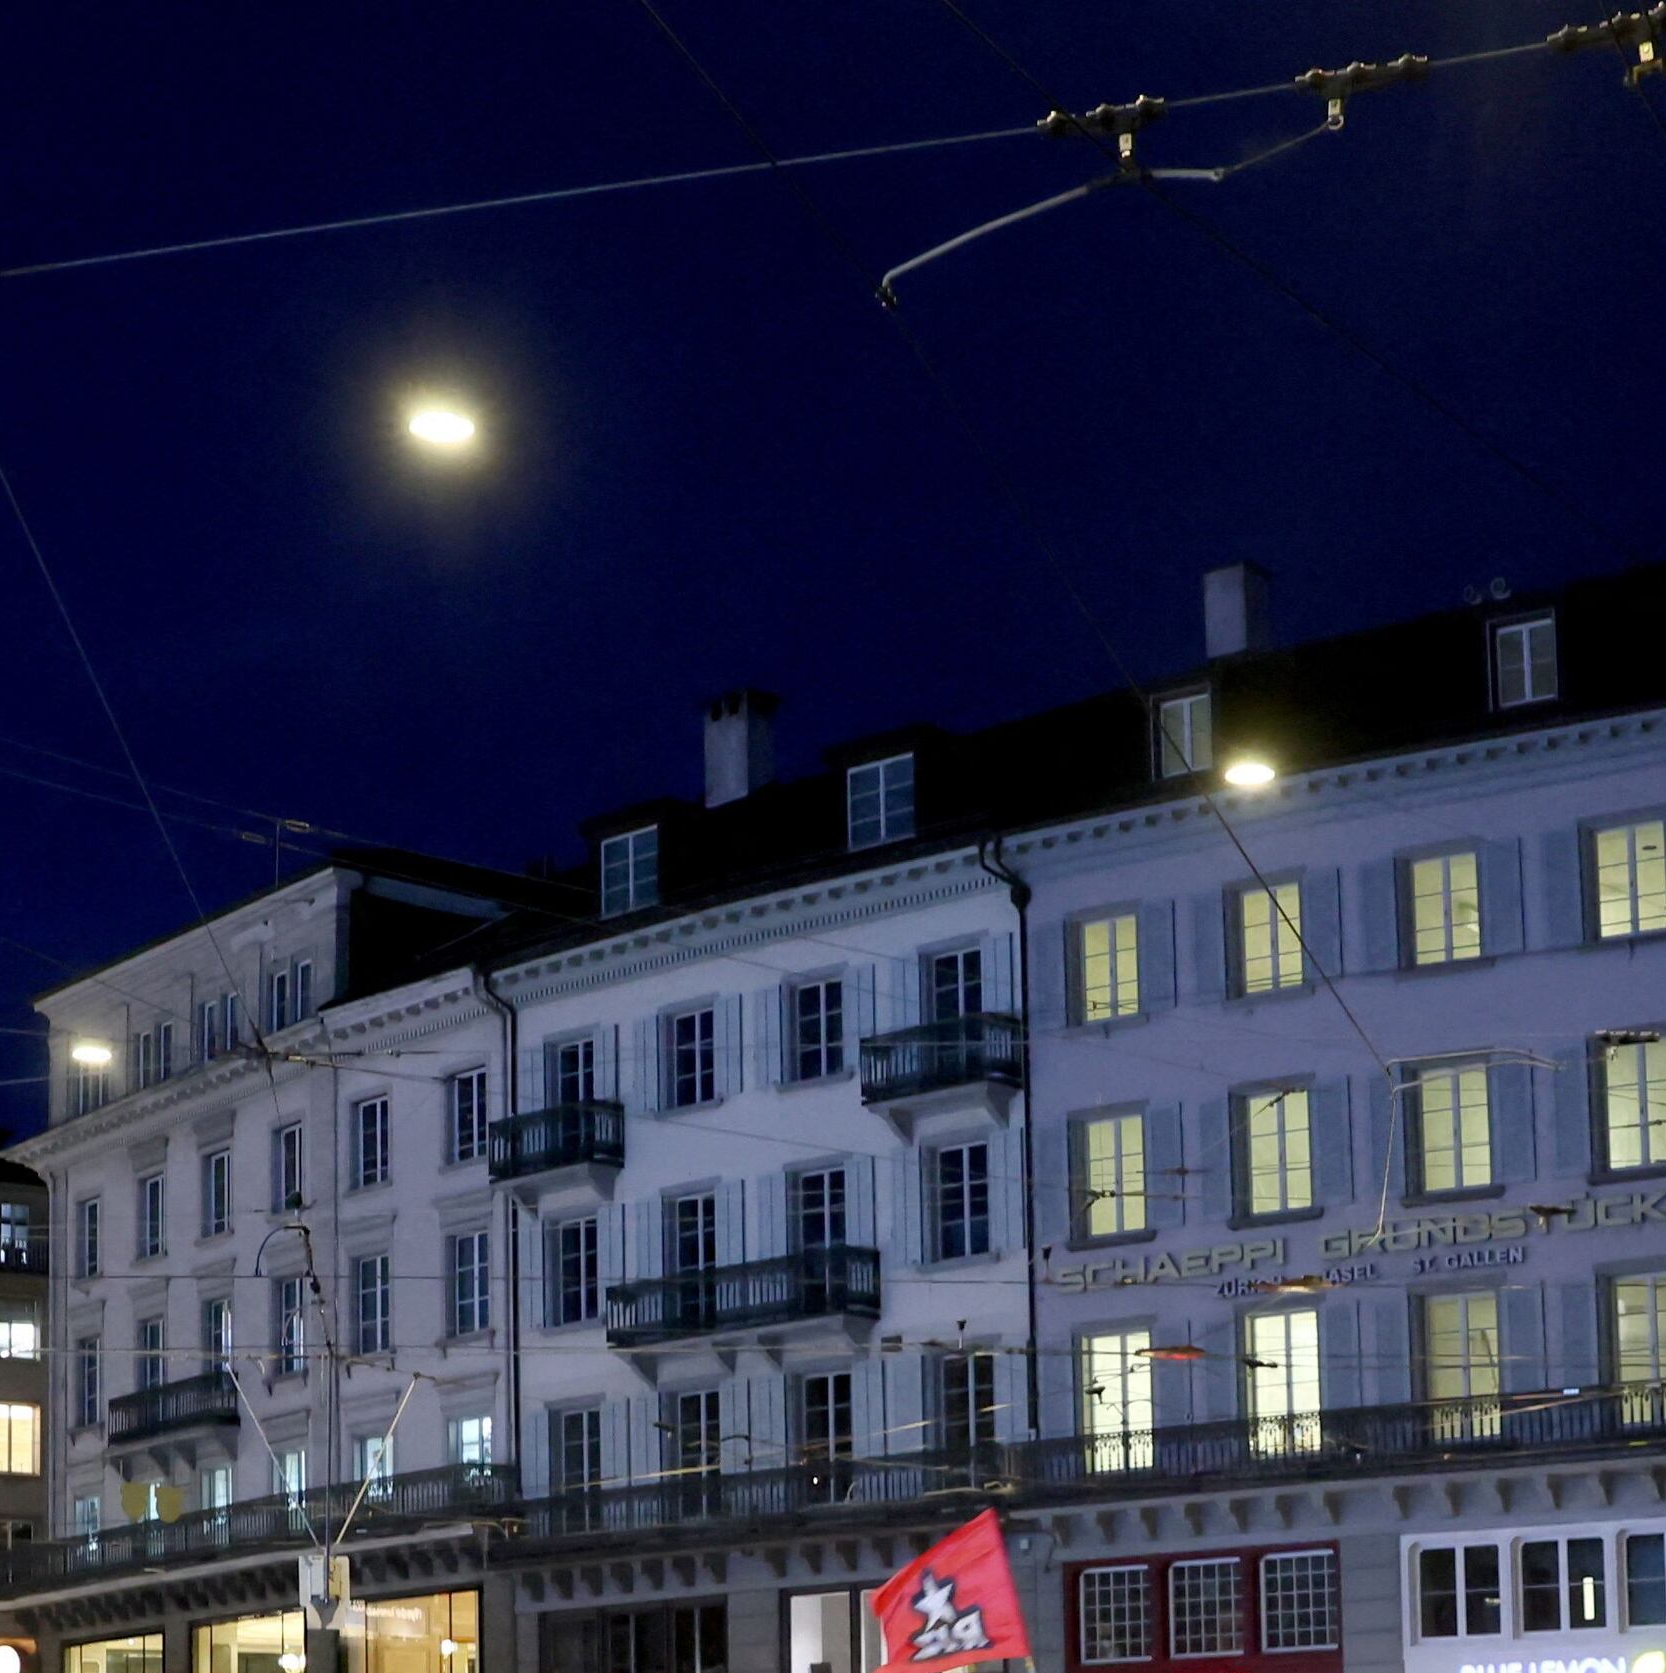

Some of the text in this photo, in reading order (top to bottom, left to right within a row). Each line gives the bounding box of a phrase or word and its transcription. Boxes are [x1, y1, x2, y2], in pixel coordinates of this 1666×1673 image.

[1057, 1239, 1284, 1293] SCHAEPPI
[1318, 1263, 1376, 1285] ASEL
[1446, 1247, 1524, 1269] GALLEN
